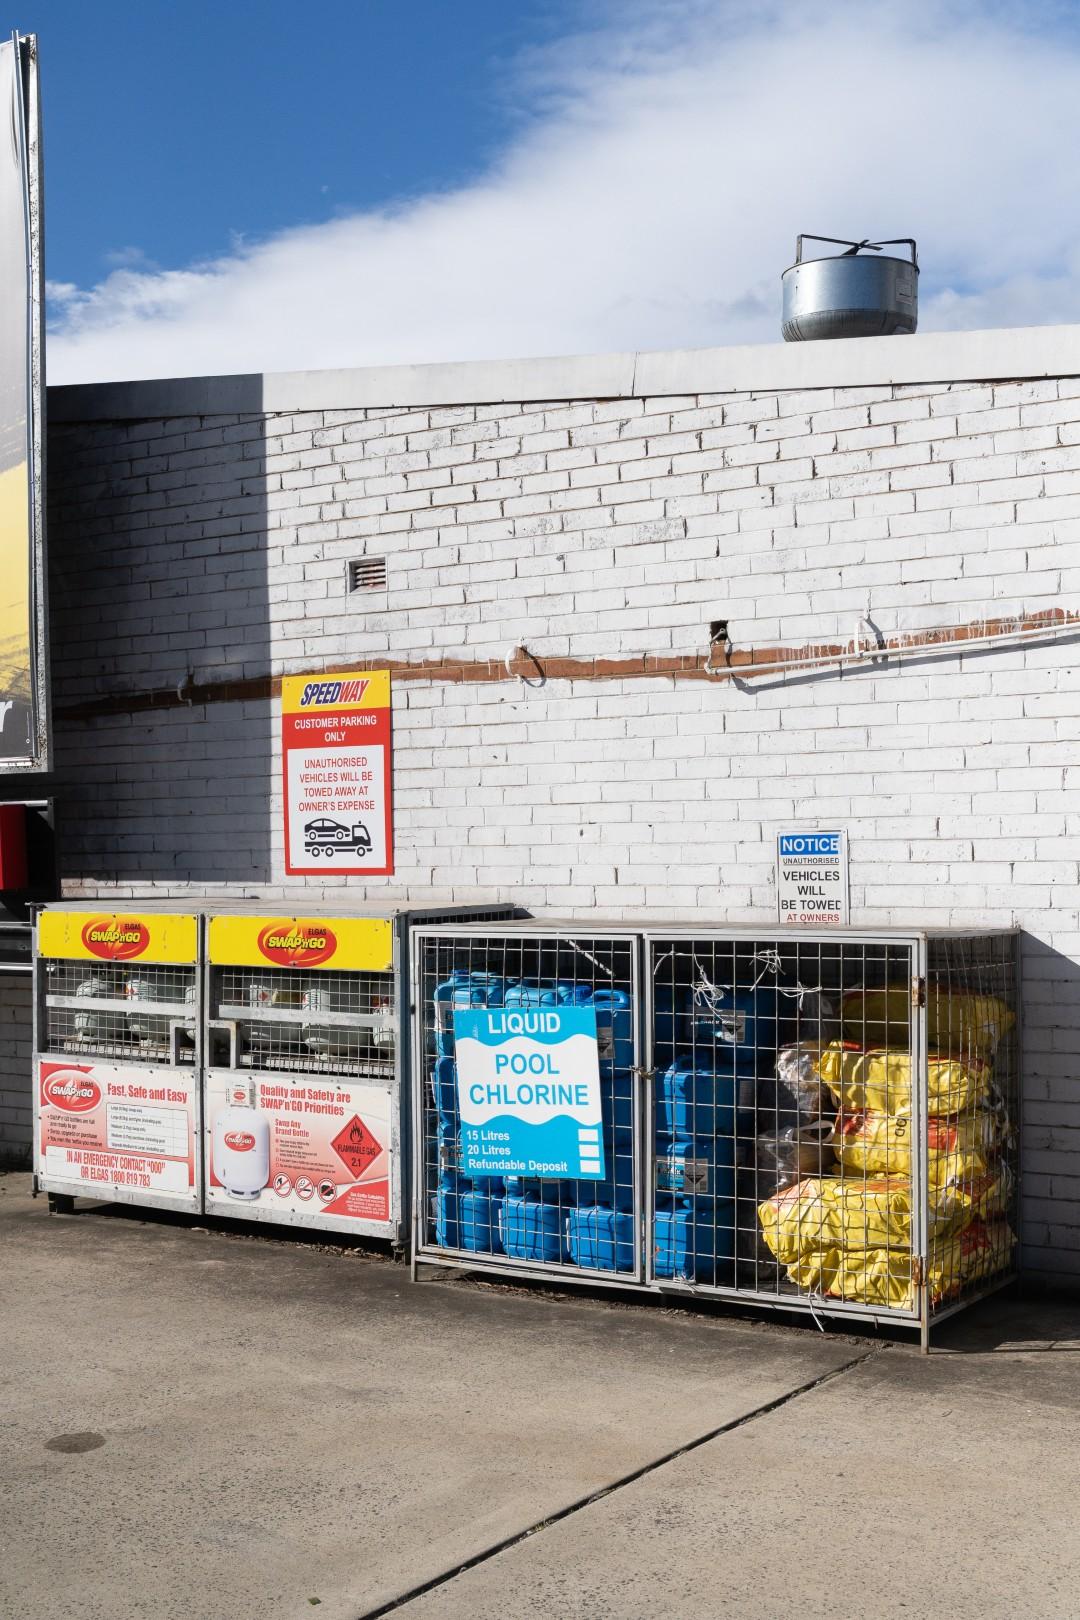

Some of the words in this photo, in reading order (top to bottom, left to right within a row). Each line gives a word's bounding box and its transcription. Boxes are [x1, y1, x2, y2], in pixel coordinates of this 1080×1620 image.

[300, 679, 370, 706] SPEEDWAY
[294, 717, 339, 730] CUSTOMER
[340, 714, 377, 727] PARKING
[324, 731, 346, 743] ONLY
[304, 756, 368, 769] UNAUTHORISED
[299, 772, 338, 783] VEHICLES
[339, 771, 360, 782] WILL
[361, 770, 373, 781] BE
[304, 786, 333, 798] TOWED
[334, 786, 357, 797] AWAY
[358, 785, 369, 796] AT
[298, 801, 336, 812] OWNER'S
[337, 800, 375, 811] EXPENSE
[783, 838, 839, 852] NOTICE
[783, 857, 840, 865] UNAUTHORISED
[783, 871, 840, 881] VEHICLES
[797, 886, 826, 896] WILL
[781, 900, 797, 910] BE
[787, 913, 798, 922] AT
[800, 913, 840, 922] OWNERS
[308, 928, 327, 936] ELGAS
[488, 1012, 561, 1035] LIQUID
[495, 1053, 560, 1075] POOL
[128, 1084, 148, 1099] Safe
[149, 1087, 166, 1101] and
[167, 1088, 188, 1104] Easy
[260, 1084, 289, 1099] Quality
[290, 1087, 306, 1100] and
[307, 1088, 335, 1103] Safety
[336, 1092, 351, 1104] are
[469, 1084, 590, 1106] CHLORINE
[304, 1101, 345, 1116] Priorities
[275, 1118, 290, 1128] Swap
[291, 1120, 301, 1129] Any
[275, 1127, 292, 1136] Brand
[293, 1129, 310, 1138] Bottle
[466, 1130, 479, 1141] 15
[481, 1130, 510, 1141] Litres
[337, 1144, 366, 1155] FLAMMABLE
[366, 1147, 376, 1156] GAS
[467, 1144, 480, 1155] 20
[482, 1144, 511, 1155] Litres
[66, 1150, 73, 1162] IN
[74, 1151, 83, 1163] AN
[83, 1152, 119, 1169] EMERGENCY
[119, 1156, 146, 1172] CONTACT
[351, 1157, 361, 1167] 2.1
[469, 1159, 526, 1170] Refundable
[529, 1160, 568, 1173] Deposit
[80, 1166, 89, 1178] OR
[90, 1168, 109, 1181] ELGAS
[110, 1171, 125, 1184] 1800
[139, 1175, 151, 1187] 783
